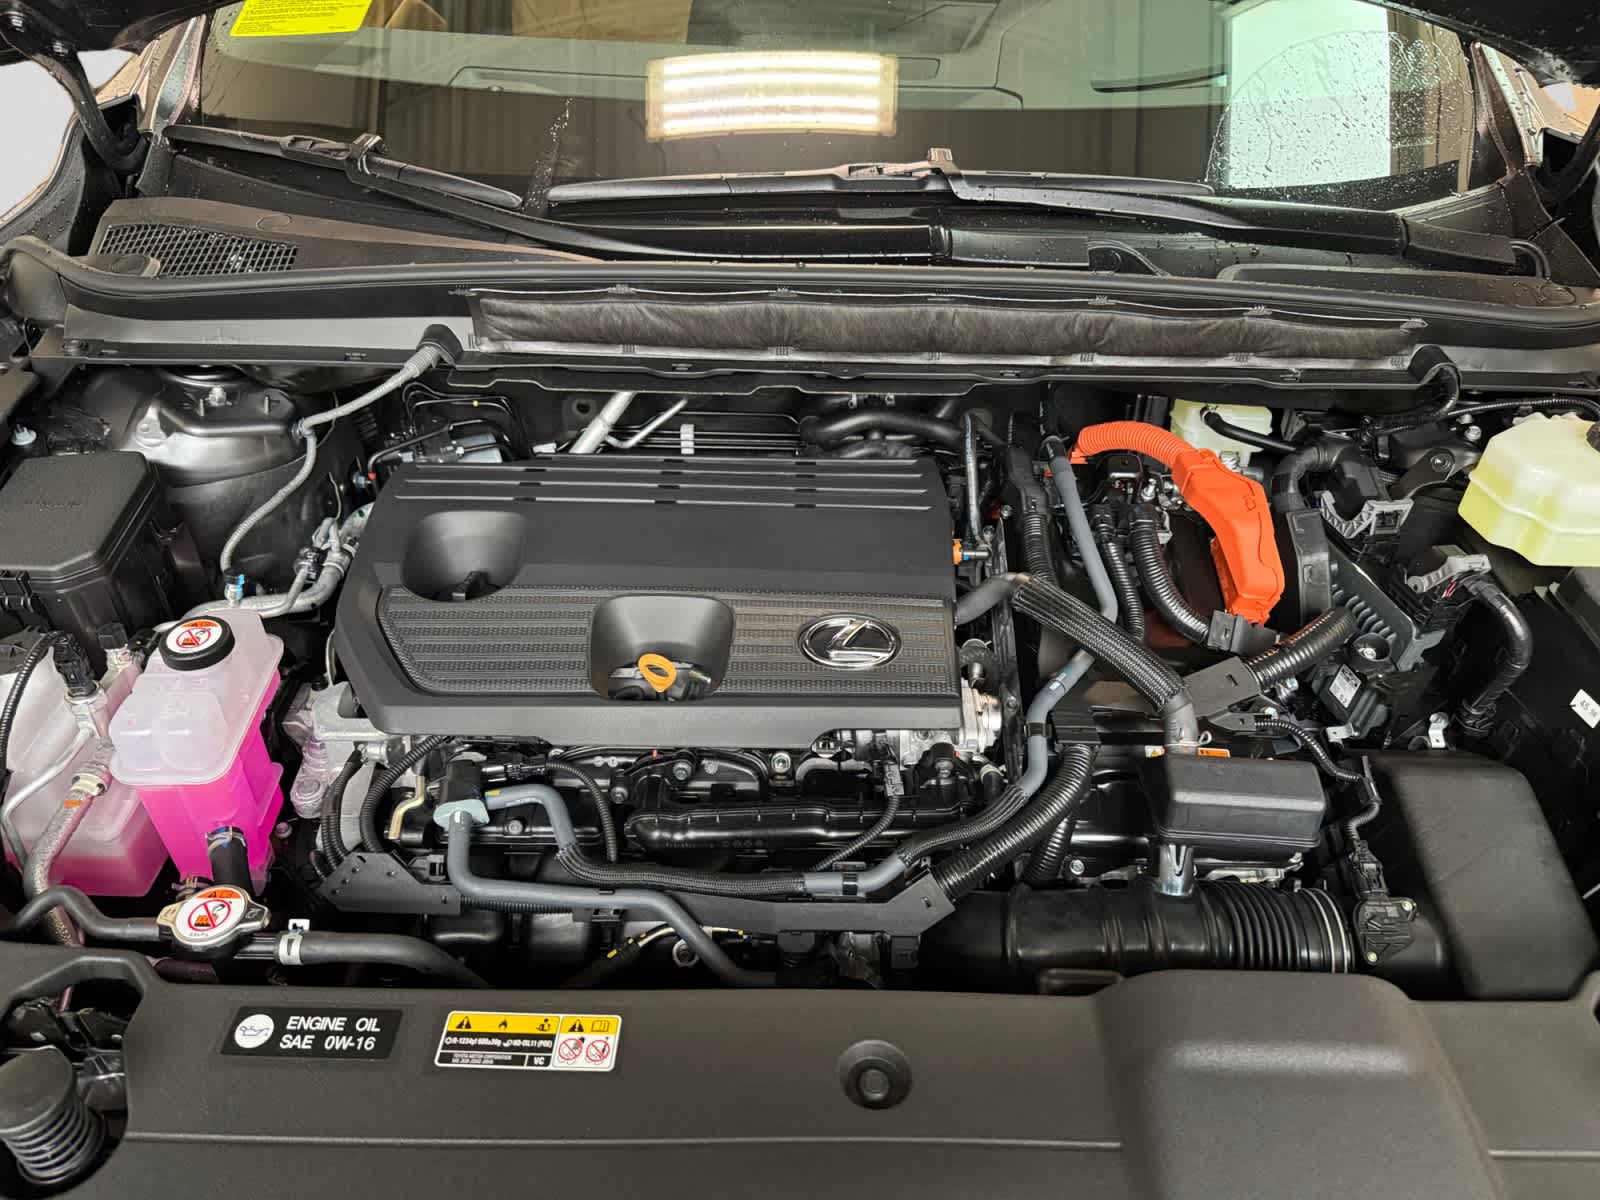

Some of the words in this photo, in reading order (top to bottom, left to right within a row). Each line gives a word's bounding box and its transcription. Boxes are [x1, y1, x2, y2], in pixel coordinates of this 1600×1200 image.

[286, 1016, 347, 1031] ENGINE
[355, 1017, 381, 1032] OIL
[279, 1034, 315, 1049] SAE
[324, 1035, 376, 1050] 0W-16
